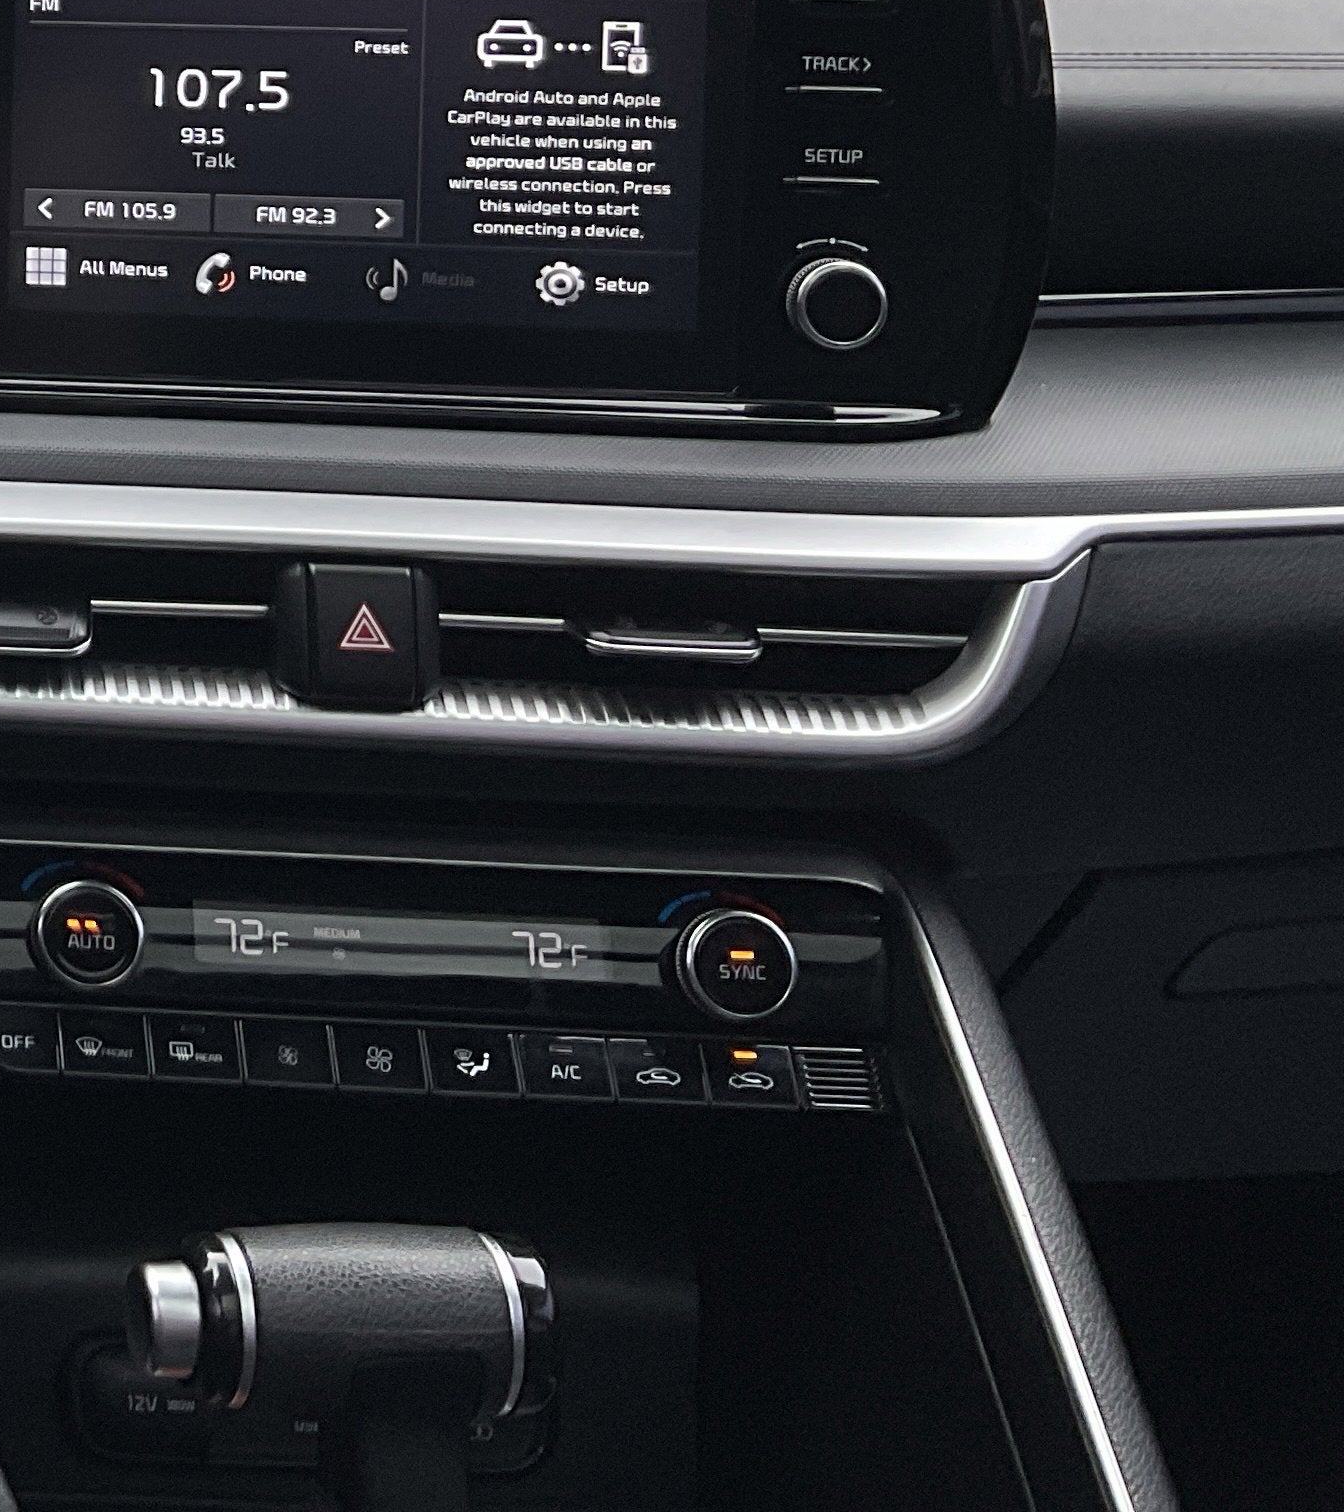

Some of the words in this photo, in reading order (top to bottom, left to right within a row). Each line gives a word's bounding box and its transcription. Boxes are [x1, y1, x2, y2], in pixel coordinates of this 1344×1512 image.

[355, 41, 408, 55] Preset
[150, 67, 289, 111] 107.5
[464, 89, 529, 104] Android
[534, 91, 574, 105] Auto
[578, 92, 608, 105] and
[613, 93, 661, 109] Apple
[448, 110, 510, 127] CarPlay
[514, 114, 542, 126] are
[547, 113, 620, 127] available
[625, 115, 640, 128] in
[645, 115, 677, 130] this
[180, 128, 224, 145] 93.5
[471, 134, 530, 148] vehicle
[535, 135, 578, 149] when
[583, 138, 627, 151] using
[631, 138, 652, 151] an
[192, 151, 235, 169] Talk
[466, 157, 545, 171] approved
[550, 157, 583, 170] USB
[587, 158, 632, 172] cable
[637, 161, 655, 172] or
[804, 148, 863, 164] SETUP
[449, 177, 517, 191] wireless
[521, 180, 620, 194] connection.
[624, 182, 671, 195] Press
[85, 202, 113, 217] FM
[123, 202, 176, 220] 105.9
[256, 207, 286, 222] FM
[293, 208, 336, 224] 92.3
[480, 199, 511, 213] this
[515, 200, 570, 216] widget
[575, 202, 593, 215] to
[597, 203, 639, 216] start
[473, 222, 566, 238] connecting
[571, 225, 581, 237] a
[585, 224, 644, 239] device.
[80, 260, 103, 276] All
[109, 261, 168, 277] Menus
[250, 265, 306, 282] Phone
[422, 271, 475, 287] Media
[595, 277, 649, 295] Setup
[314, 927, 360, 939] MEDIUM
[68, 934, 115, 951] AUTO
[719, 964, 765, 981] SYNC
[1, 1034, 35, 1050] OFF
[552, 1064, 581, 1080] A/C
[127, 1395, 157, 1412] 12V
